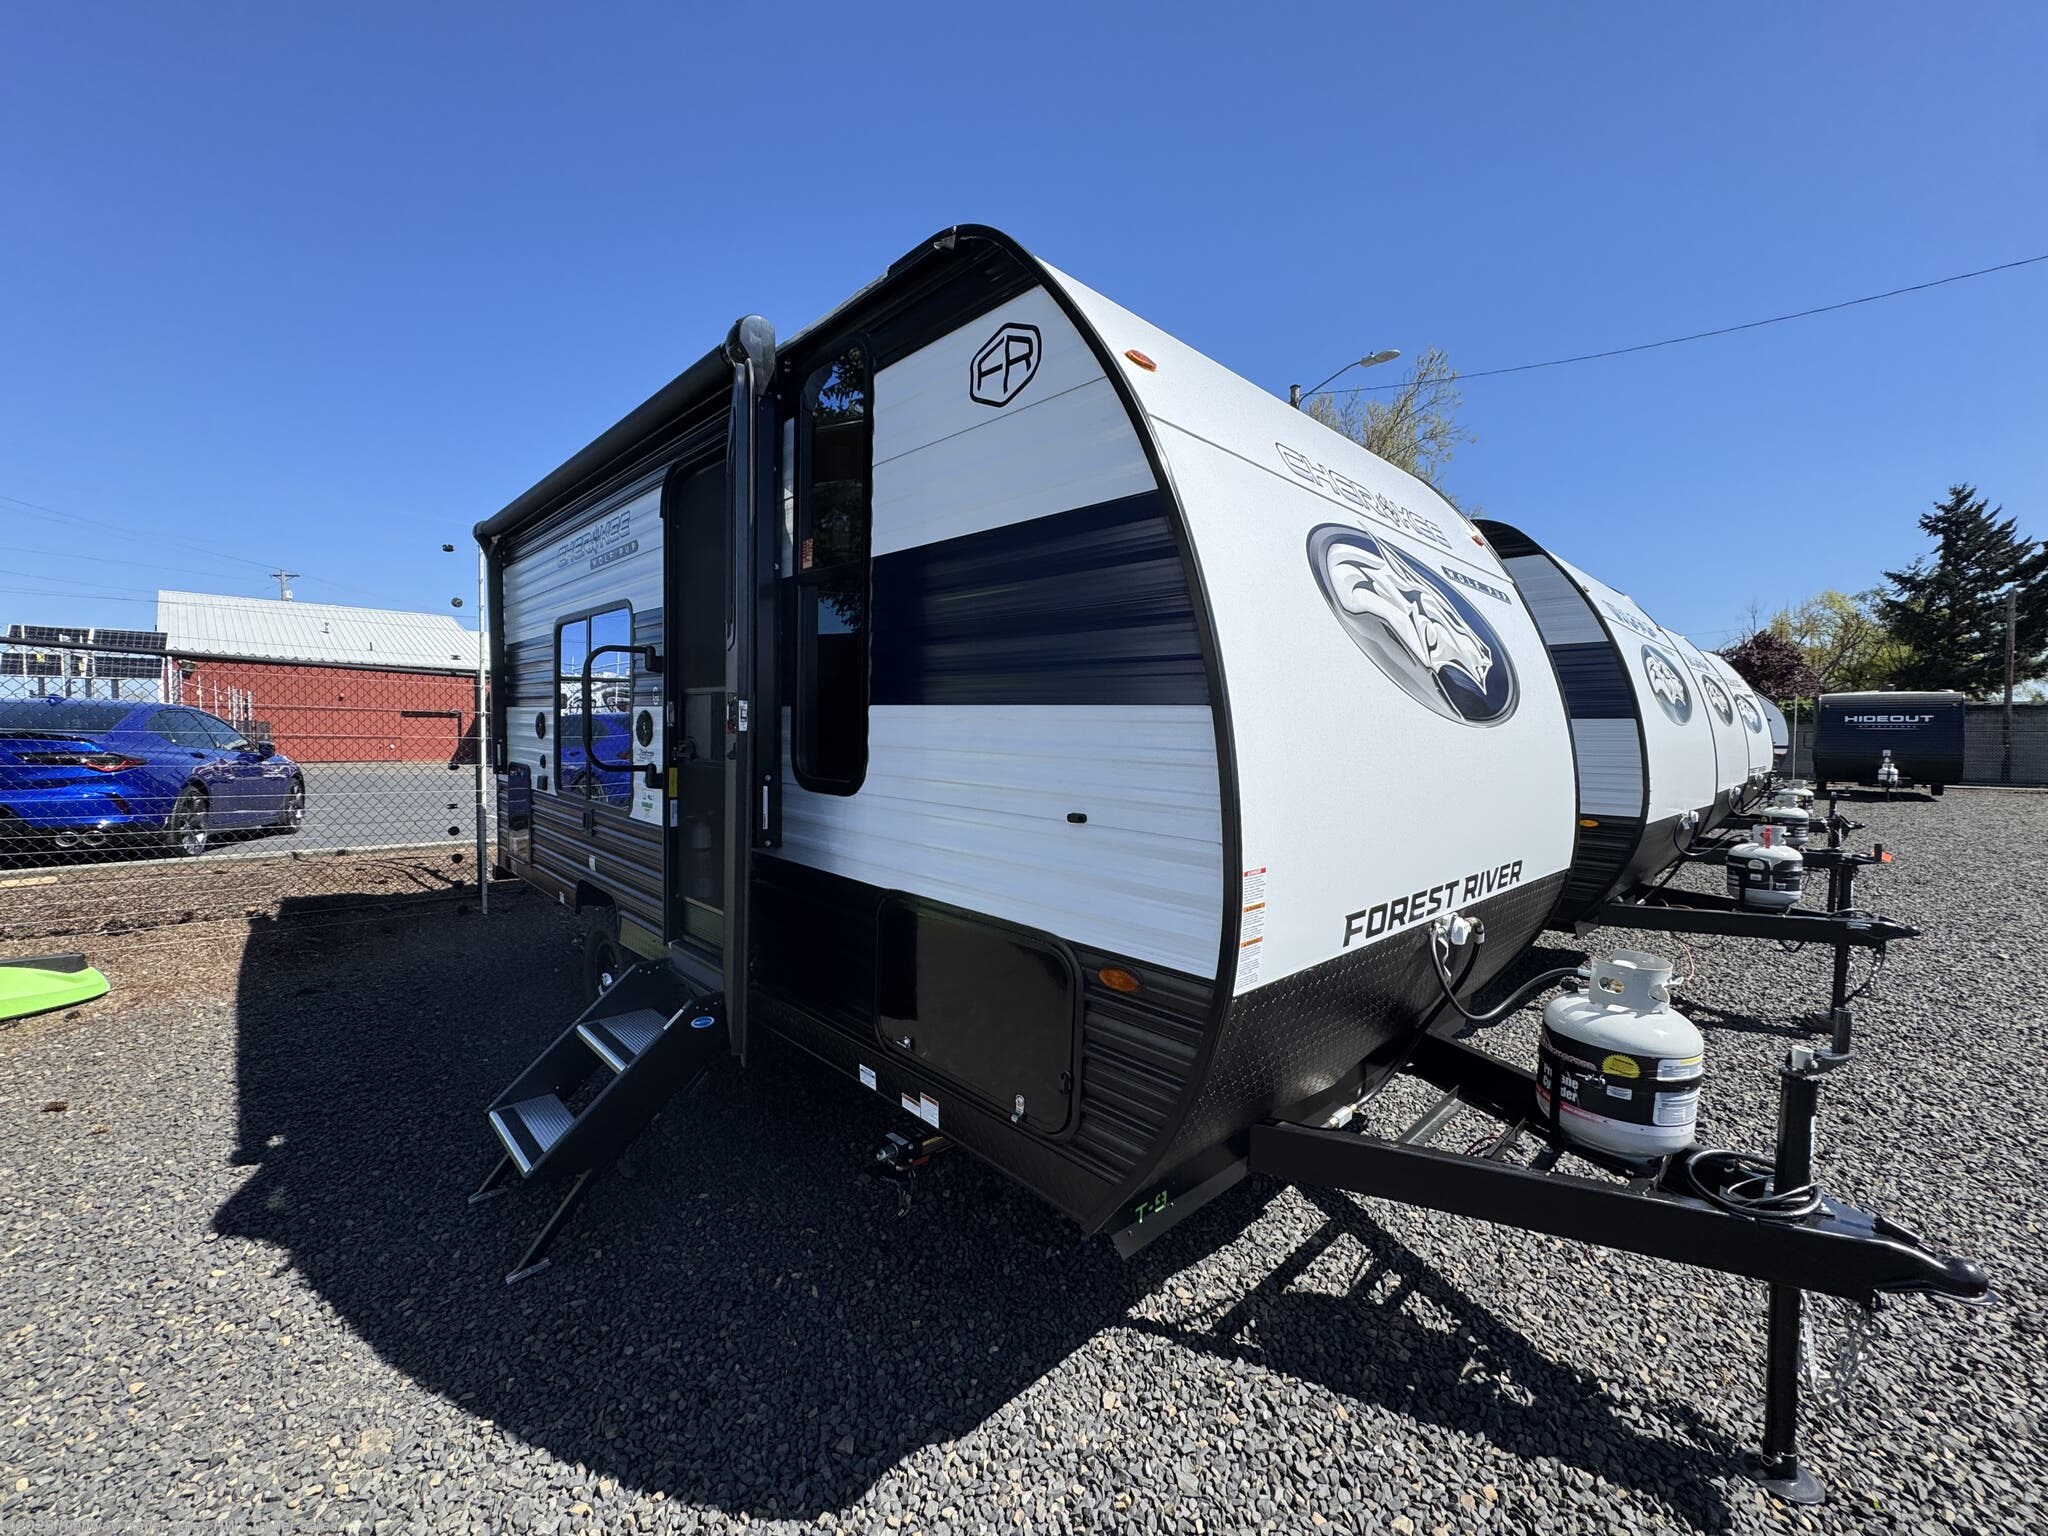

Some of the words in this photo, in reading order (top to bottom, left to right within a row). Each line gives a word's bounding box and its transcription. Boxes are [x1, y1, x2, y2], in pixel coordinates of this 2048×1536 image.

[1844, 715, 1935, 723] HIDEOUT
[1342, 879, 1459, 948] FOREST
[1462, 859, 1523, 903] RIVER
